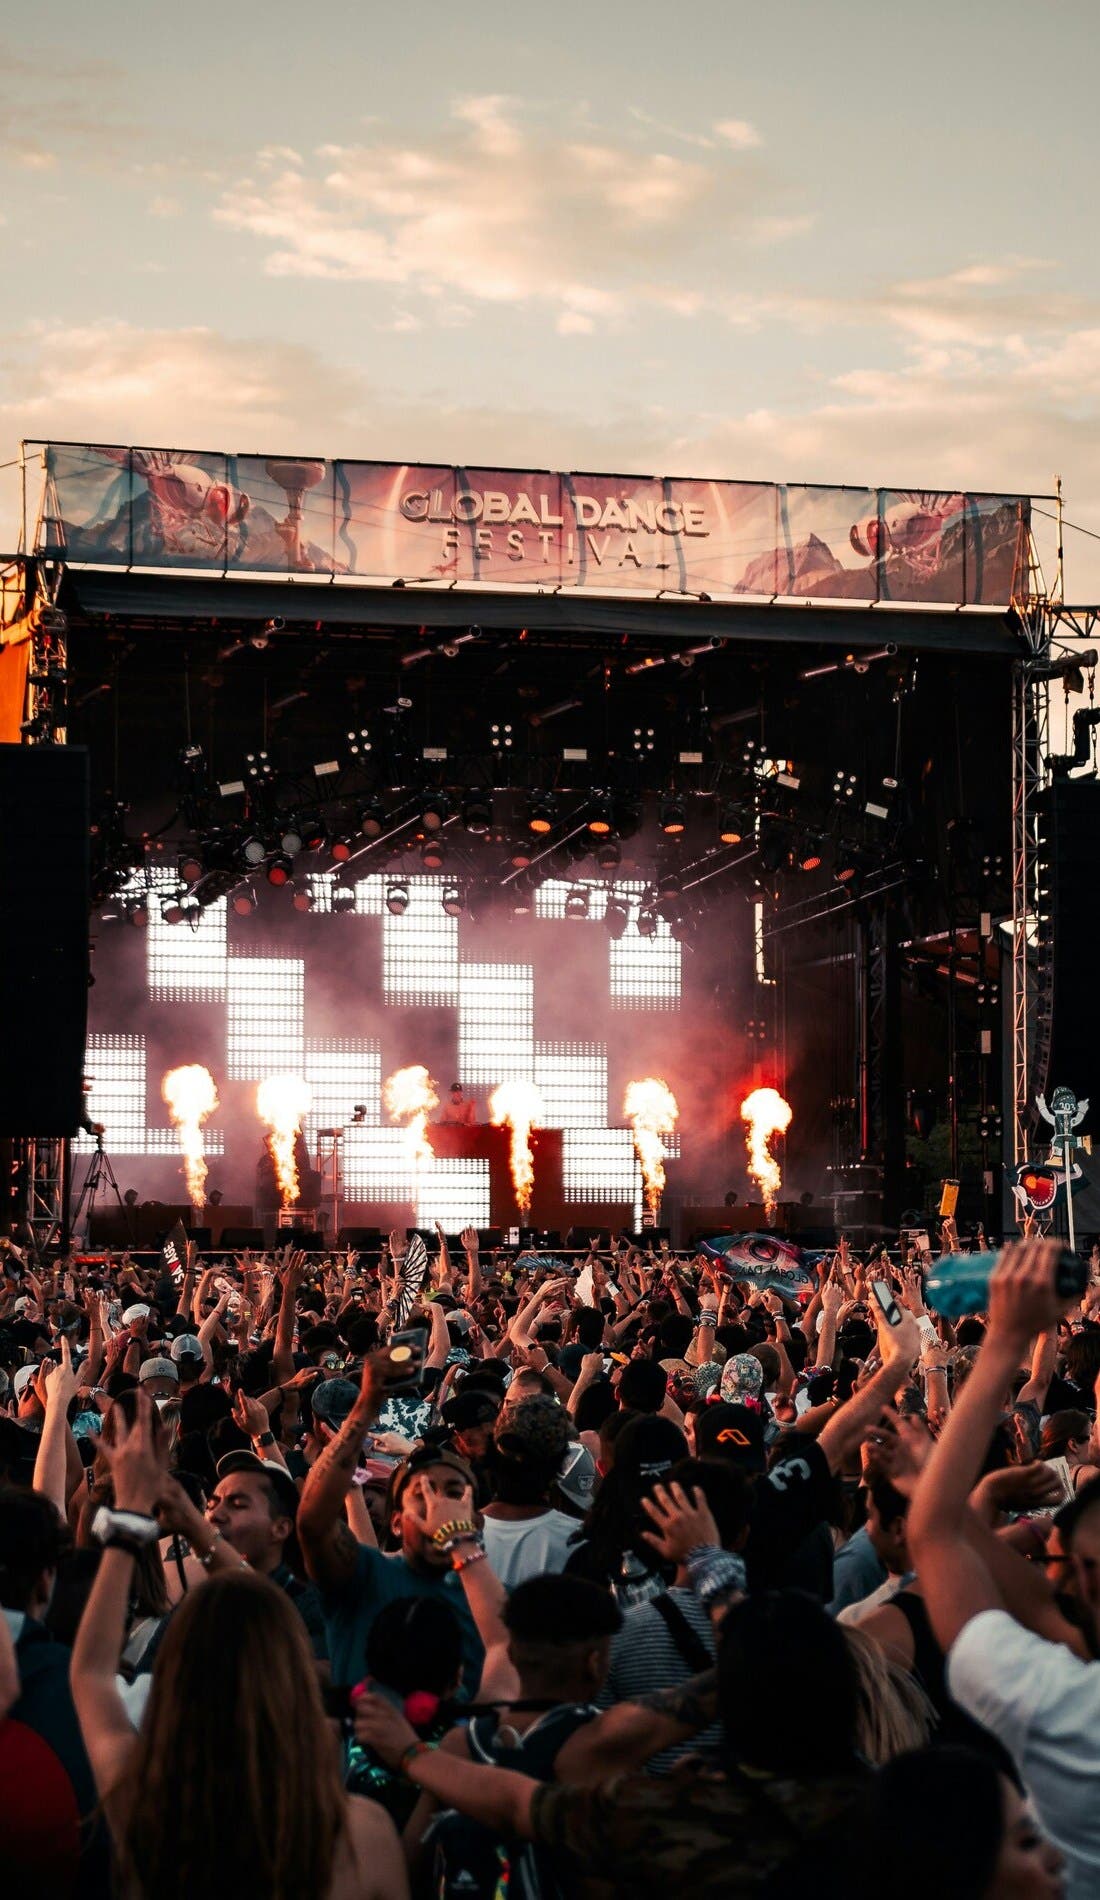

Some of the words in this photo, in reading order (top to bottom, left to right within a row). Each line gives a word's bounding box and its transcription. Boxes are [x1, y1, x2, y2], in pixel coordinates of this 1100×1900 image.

[400, 489, 564, 528] GLOBAL
[572, 496, 710, 537] DANCE
[163, 1241, 185, 1284] SAVAGE
